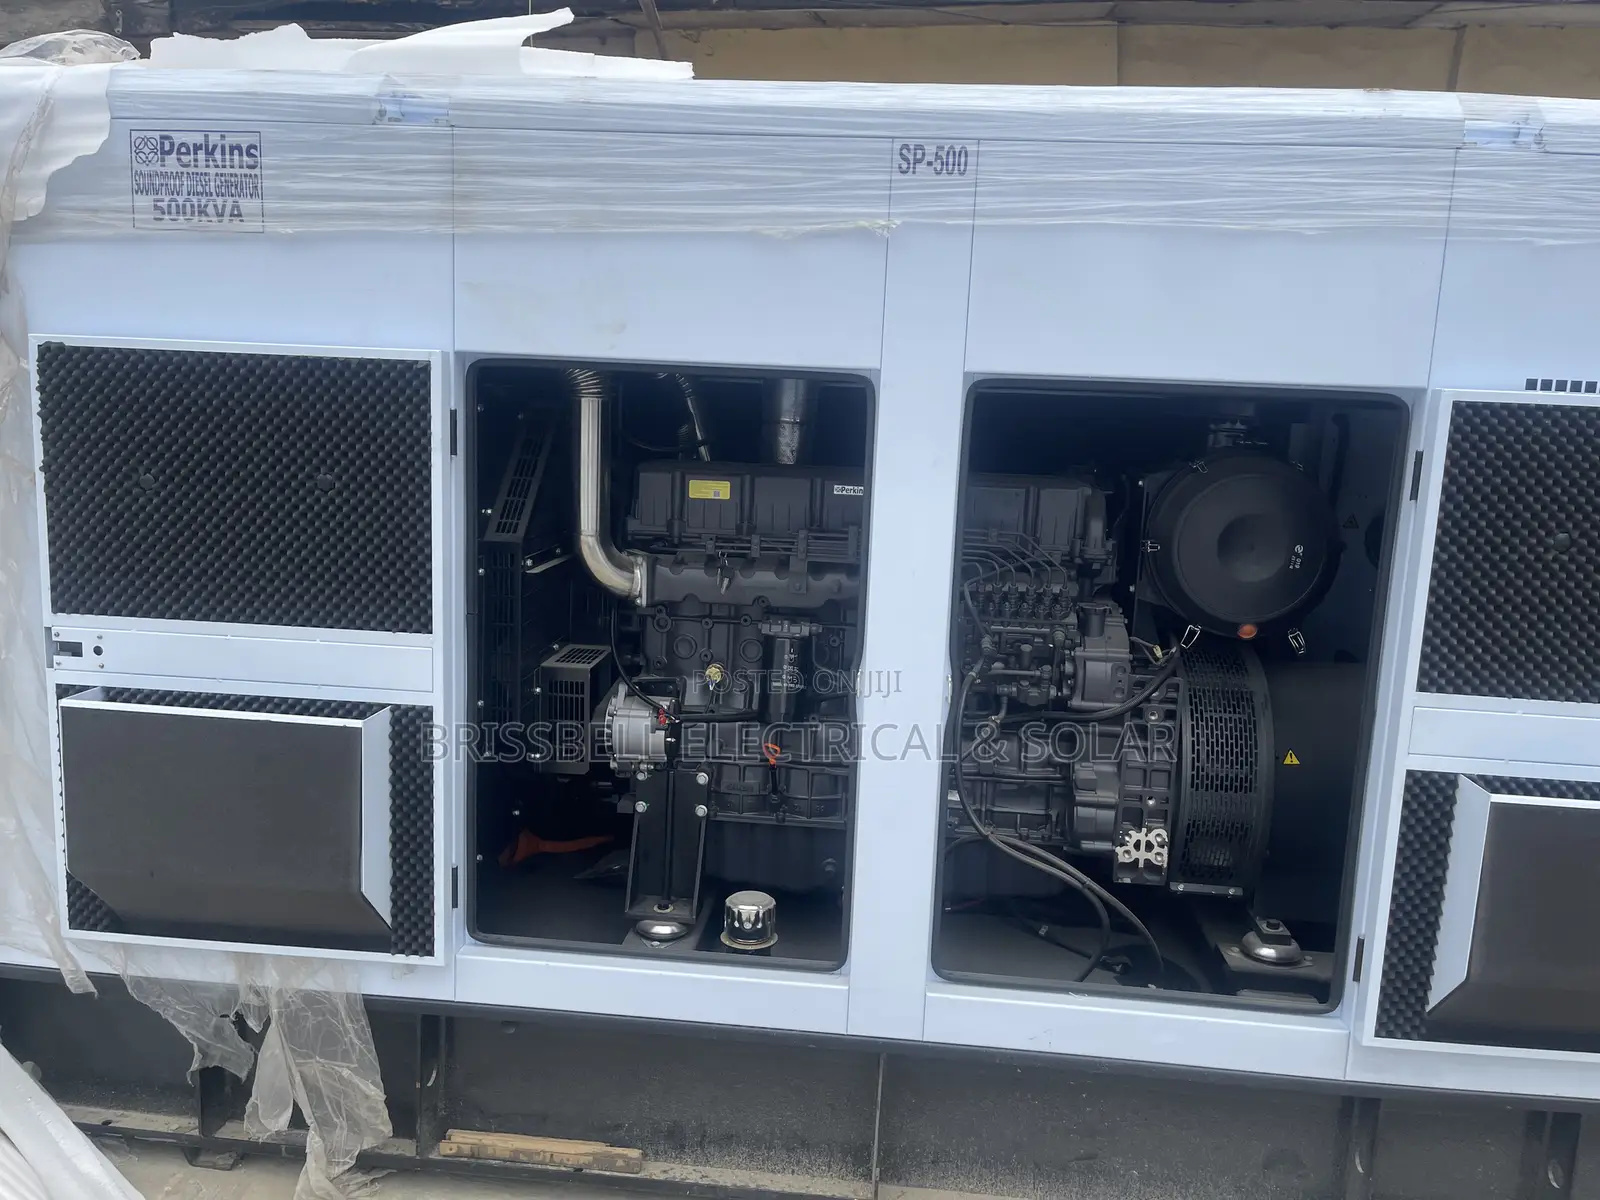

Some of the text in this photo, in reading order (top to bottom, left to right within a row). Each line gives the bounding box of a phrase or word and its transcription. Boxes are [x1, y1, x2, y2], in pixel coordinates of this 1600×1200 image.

[159, 133, 259, 169] Perkins
[898, 143, 969, 177] SP-500
[134, 169, 260, 199] SOUNDPROOF DIESEL GENERATOR
[153, 198, 244, 222] 500KVA
